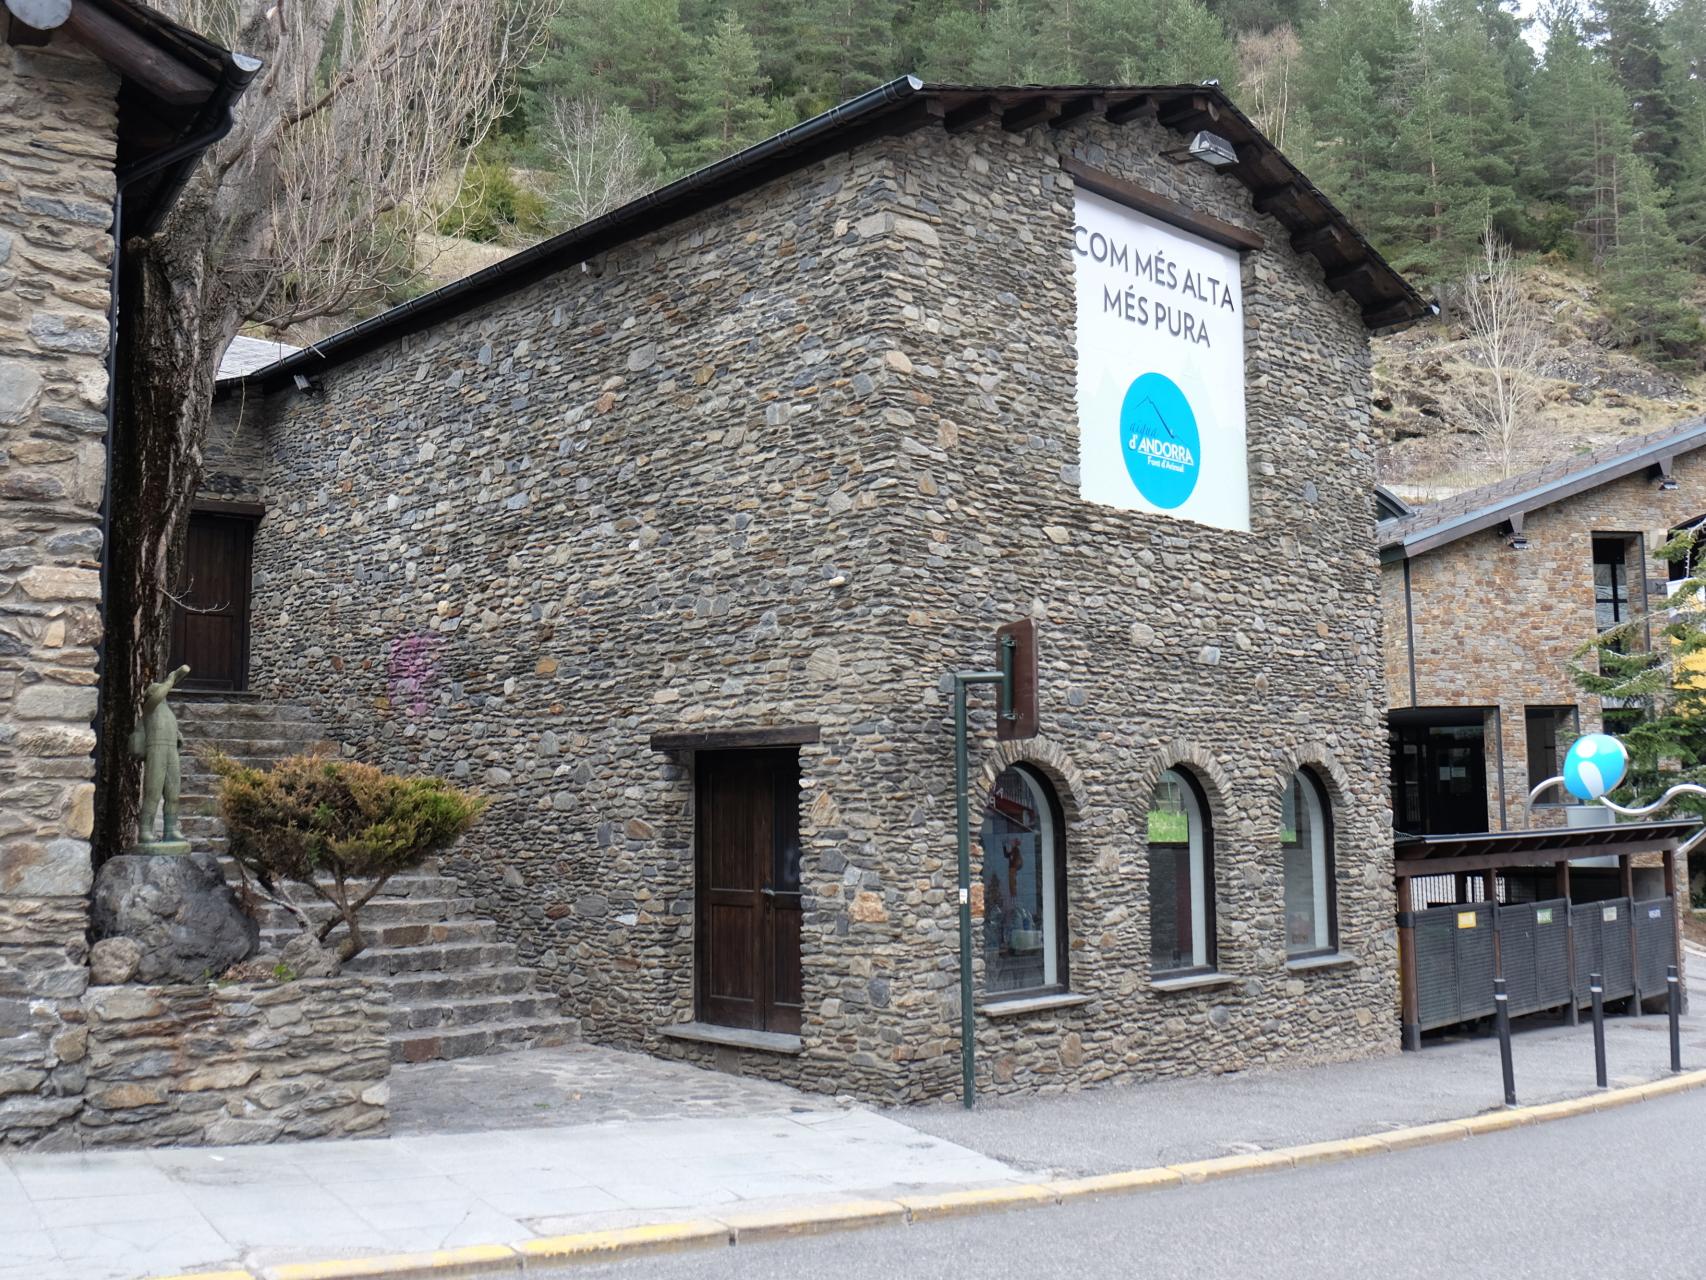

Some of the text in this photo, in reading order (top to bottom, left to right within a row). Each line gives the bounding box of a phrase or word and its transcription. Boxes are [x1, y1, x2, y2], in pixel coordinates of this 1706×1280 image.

[1073, 225, 1235, 312] COM MÉS ALTA
[1104, 284, 1211, 348] MÉS PURA
